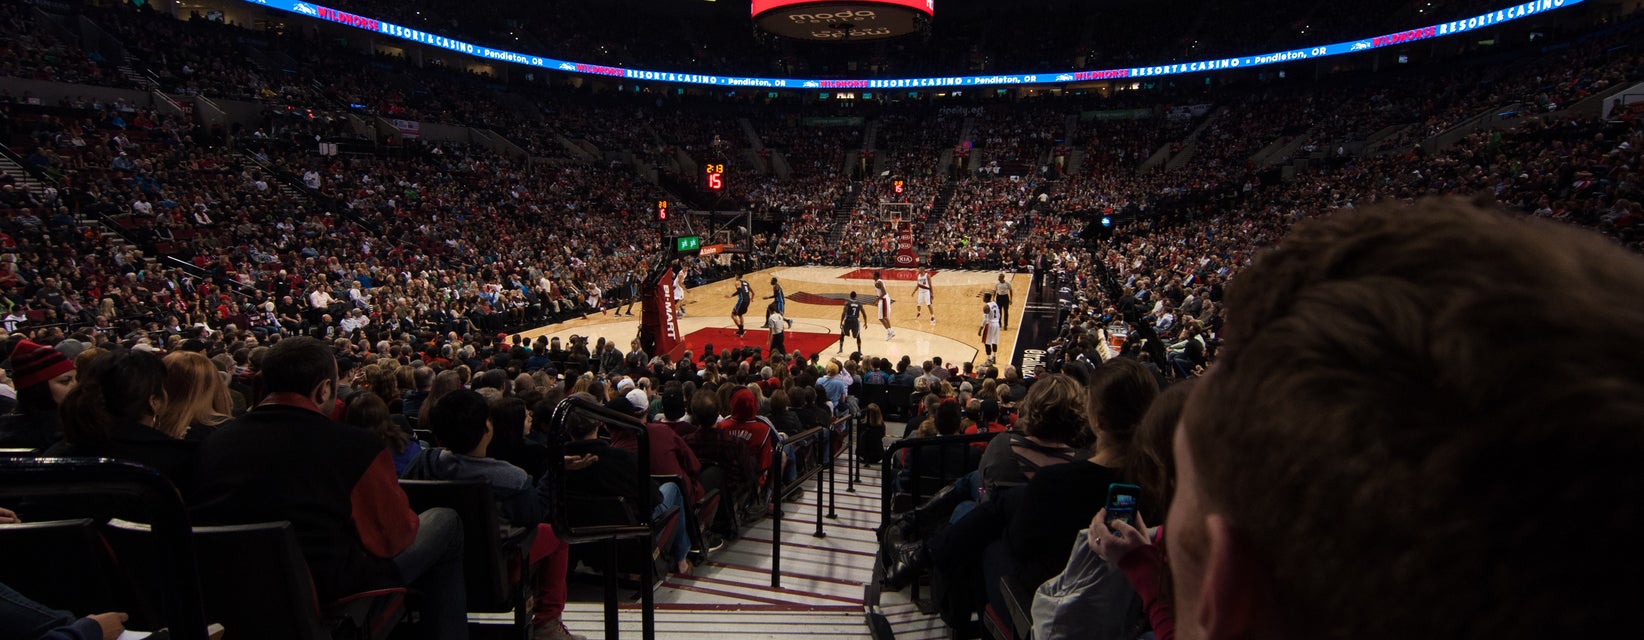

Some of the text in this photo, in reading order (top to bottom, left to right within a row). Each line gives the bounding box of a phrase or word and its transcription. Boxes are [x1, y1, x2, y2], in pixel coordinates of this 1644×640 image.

[317, 5, 379, 31] WILDHORSE
[381, 22, 424, 42] RESORT
[436, 37, 473, 54] CASINO
[484, 49, 529, 65] Pendleton,
[531, 58, 543, 66] OR
[1372, 25, 1437, 47] WILDHORSE
[1439, 13, 1493, 35] RESORT
[1507, 0, 1564, 18] CASINO
[575, 63, 625, 77] WILDHORSE
[627, 69, 667, 81] RESORT
[677, 74, 717, 84] CASINO
[728, 78, 772, 88] Pendleton,
[774, 79, 786, 87] OR
[1073, 68, 1129, 81] WILDHORSE
[1131, 65, 1177, 77] RESORT
[1190, 58, 1240, 71] CASINO
[1254, 51, 1307, 64] Pendleton,
[1311, 46, 1327, 56] OR
[819, 79, 868, 89] WILDHORSE
[870, 79, 911, 88] RESORT
[920, 77, 963, 87] CASINO
[974, 75, 1021, 85] Pendleton,
[1023, 75, 1037, 83] OR
[706, 163, 724, 173] 2:13
[709, 173, 722, 189] 15
[663, 284, 676, 340] BI-MART
